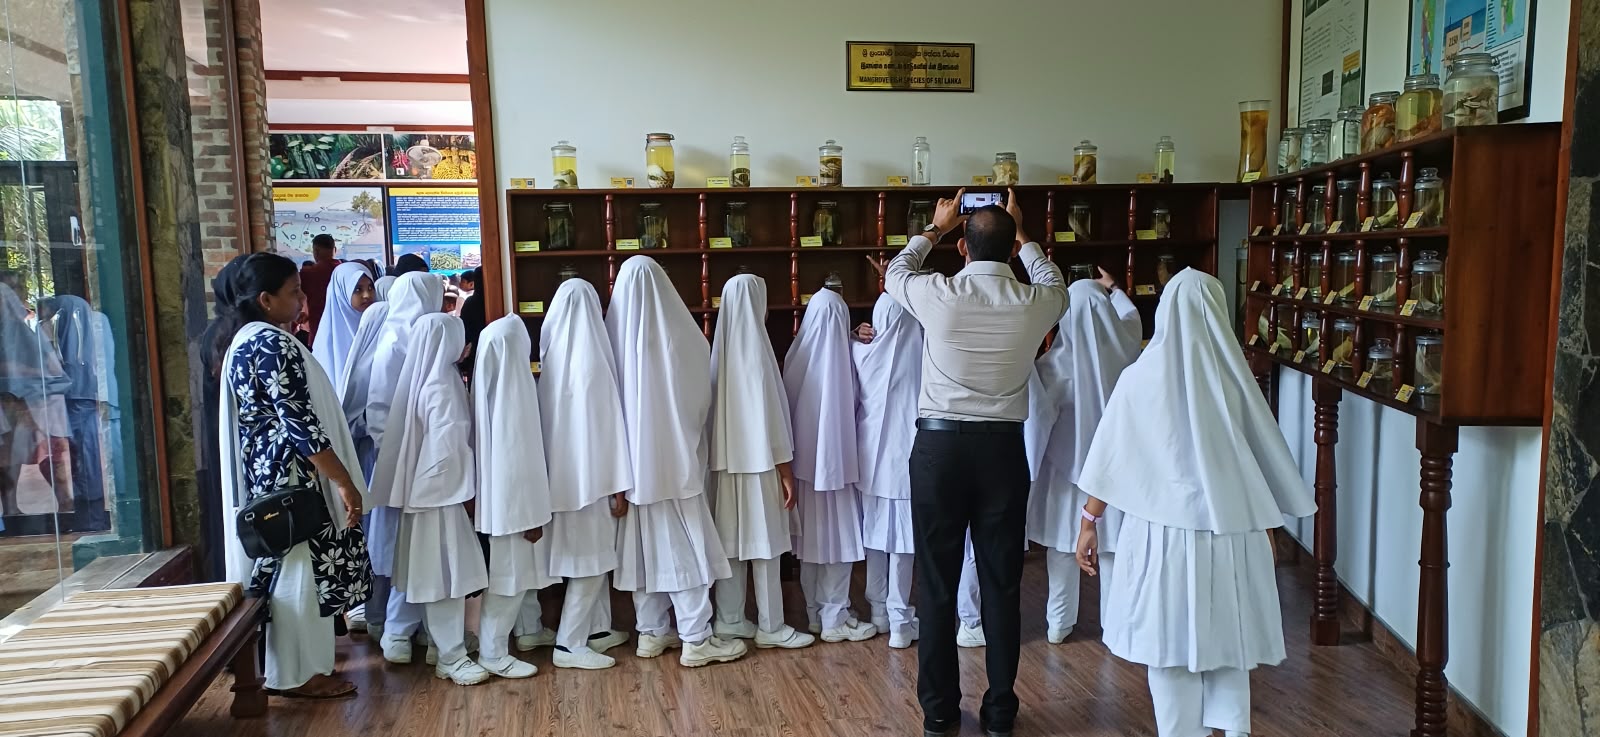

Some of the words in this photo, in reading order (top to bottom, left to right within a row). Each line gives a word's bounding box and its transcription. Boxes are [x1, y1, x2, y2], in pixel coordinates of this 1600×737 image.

[859, 76, 889, 84] MANGROVE
[890, 76, 903, 84] FISH
[904, 76, 925, 84] SPECIES
[934, 77, 943, 85] SRI
[944, 77, 962, 85] LANKA
